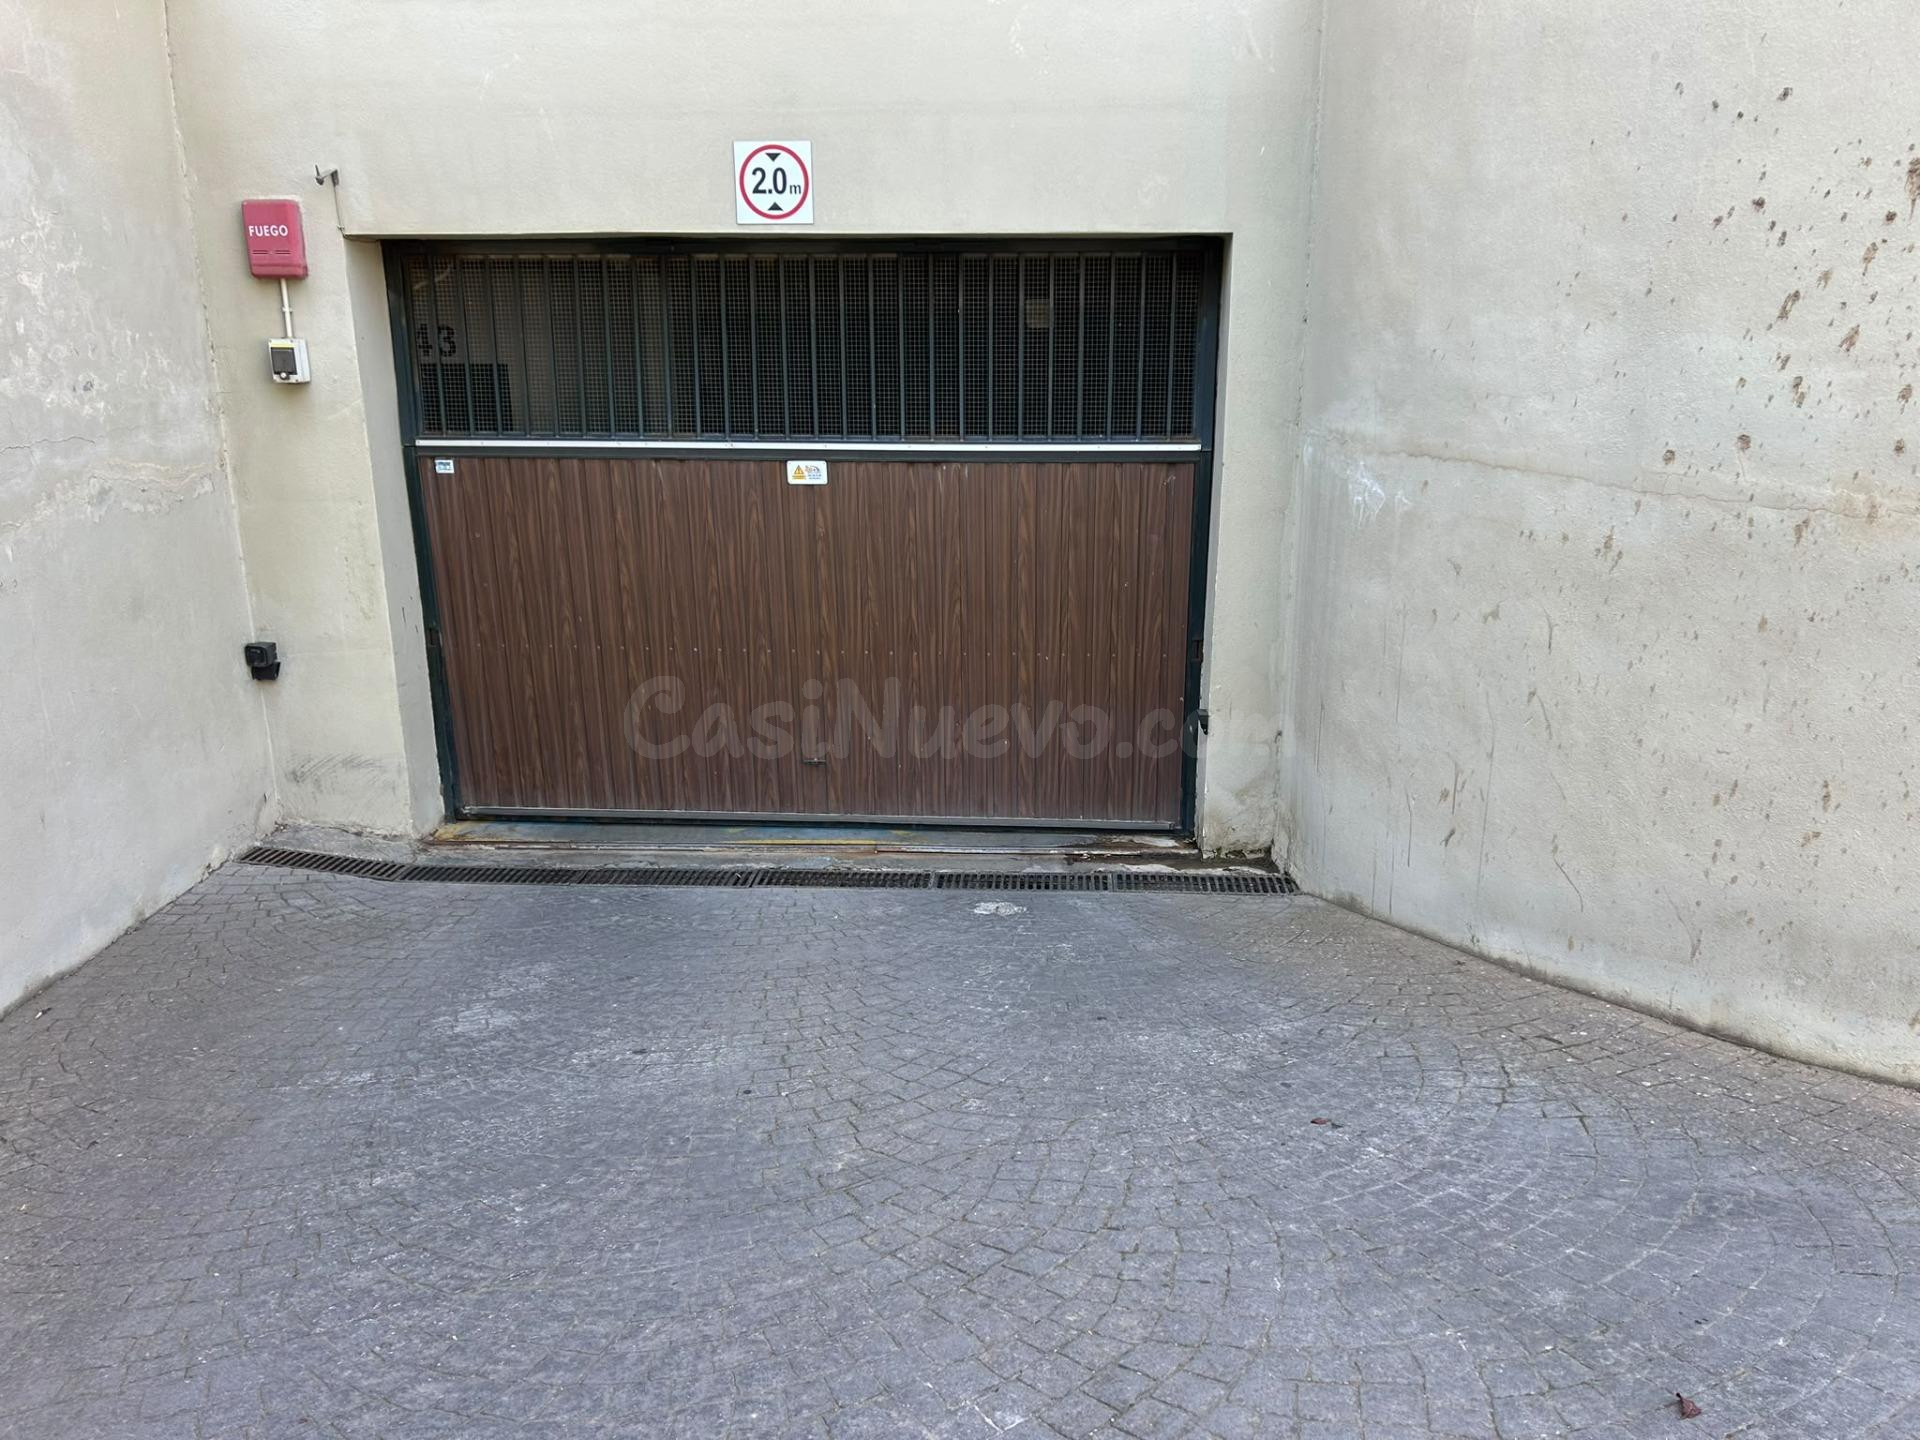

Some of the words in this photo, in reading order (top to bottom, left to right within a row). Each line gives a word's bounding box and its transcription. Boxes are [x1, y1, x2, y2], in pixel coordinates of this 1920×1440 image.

[752, 167, 787, 195] 2.0
[789, 184, 802, 195] m
[248, 224, 289, 237] FUEGO
